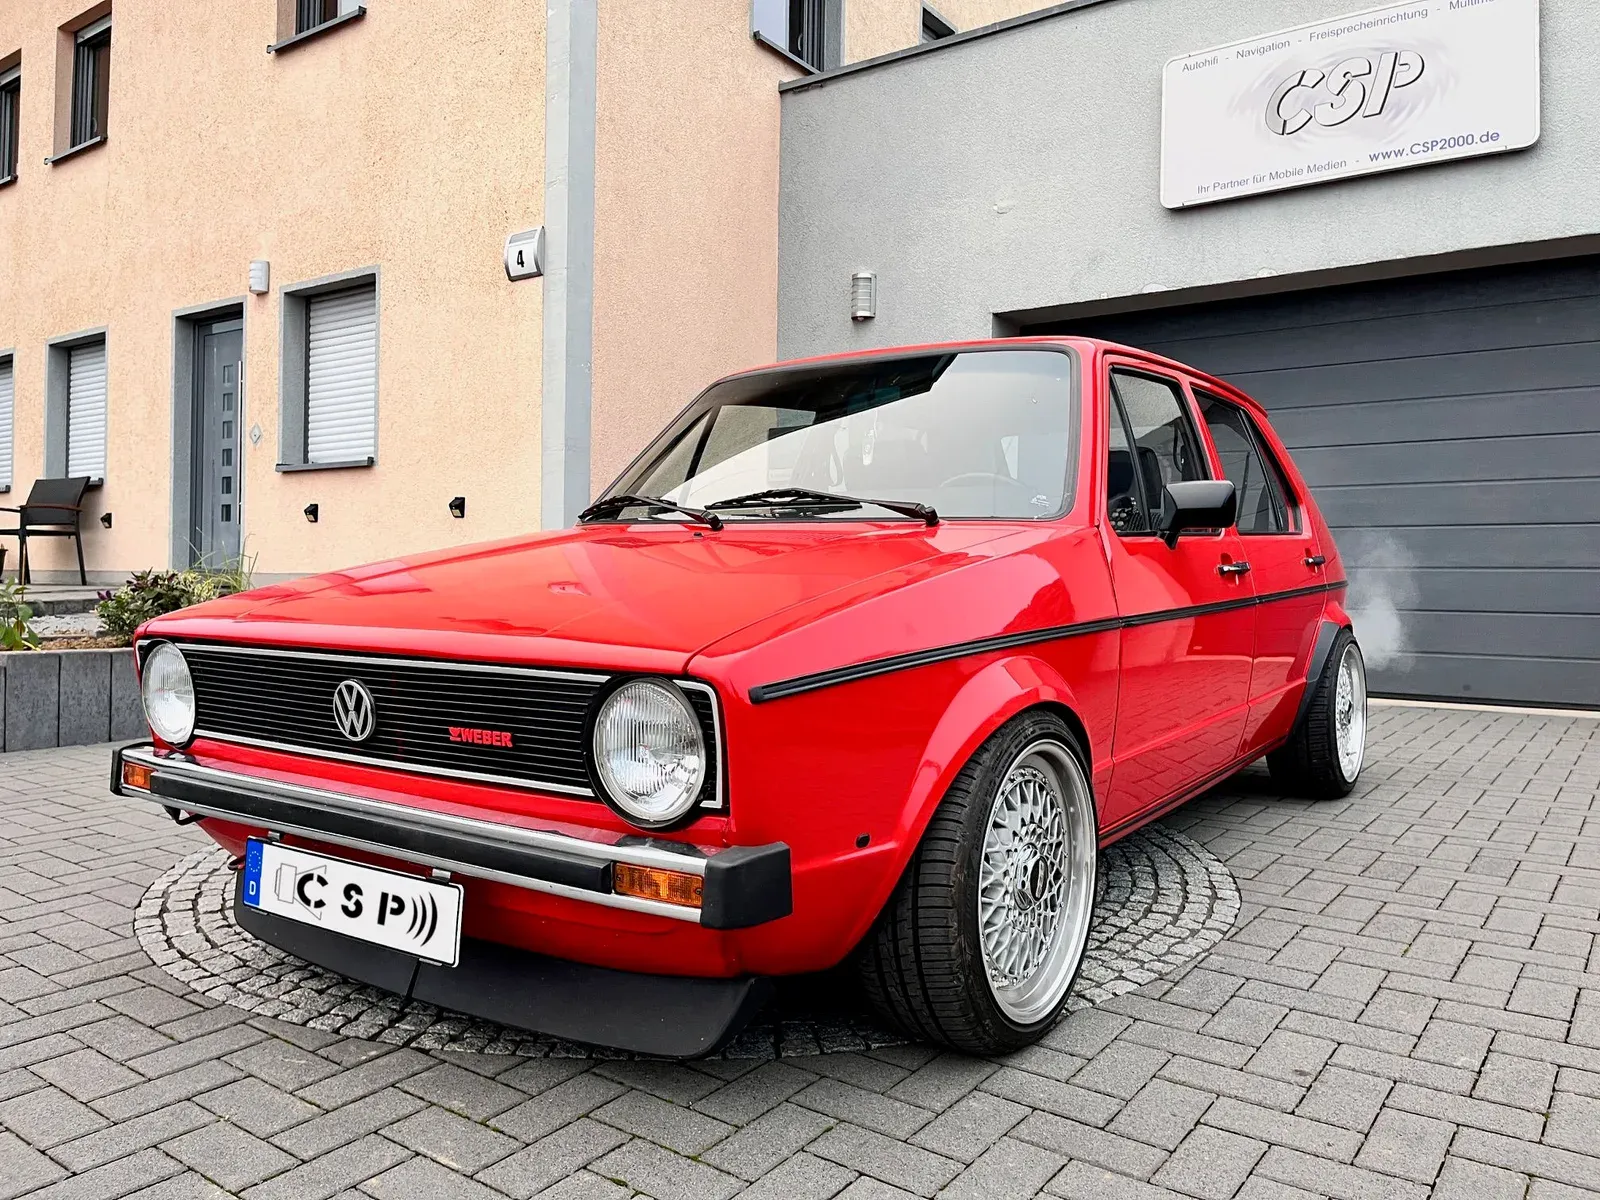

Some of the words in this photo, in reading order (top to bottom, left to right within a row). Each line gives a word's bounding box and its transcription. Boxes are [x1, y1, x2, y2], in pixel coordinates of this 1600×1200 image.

[1182, 56, 1219, 72] Autohifi
[1236, 40, 1291, 59] Navigation
[1309, 8, 1429, 42] Freisprecheinrichtung
[1265, 50, 1425, 136] CSP
[1197, 183, 1211, 194] Ihr
[1213, 178, 1250, 191] Partner
[1252, 173, 1267, 184] für
[1269, 166, 1304, 181] Mobile
[1306, 158, 1347, 174] Medien
[1368, 131, 1500, 162] www.CSP2000.de
[516, 250, 525, 268] 4
[460, 728, 514, 748] WEBER
[248, 880, 257, 896] D
